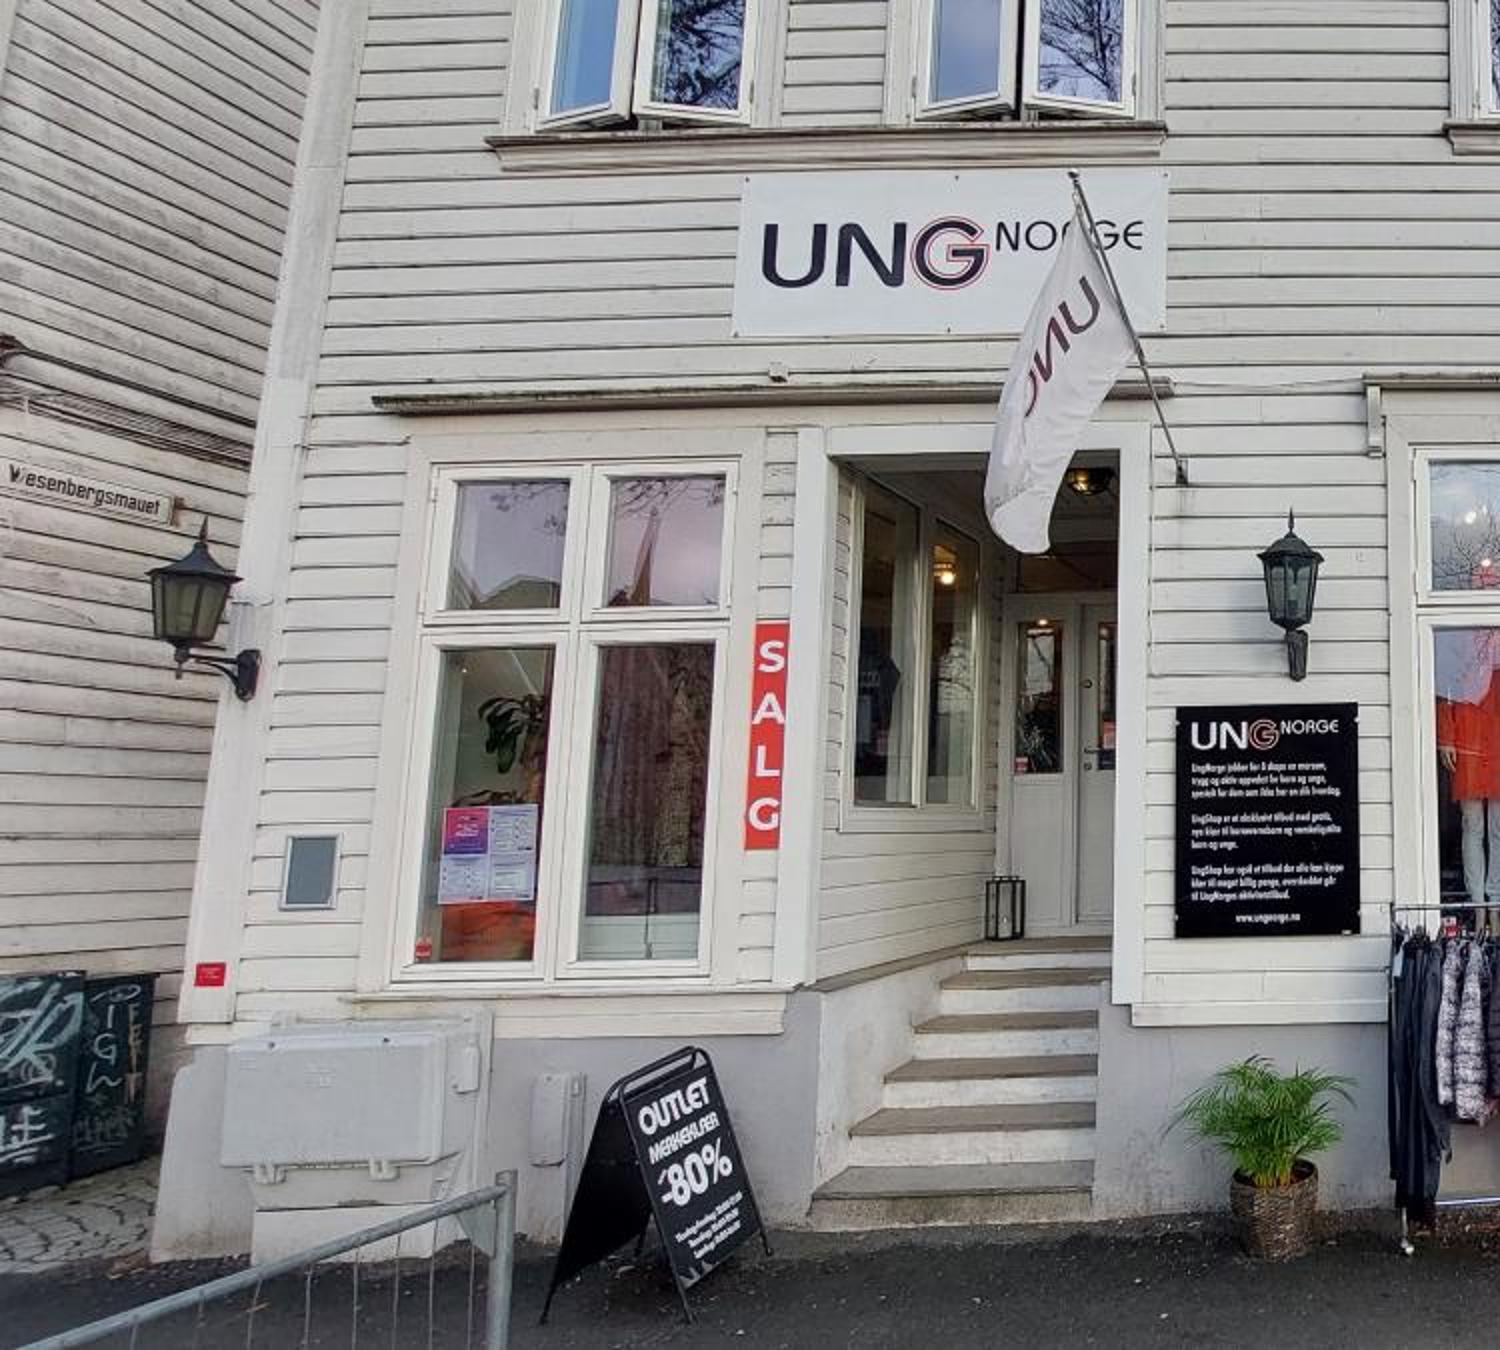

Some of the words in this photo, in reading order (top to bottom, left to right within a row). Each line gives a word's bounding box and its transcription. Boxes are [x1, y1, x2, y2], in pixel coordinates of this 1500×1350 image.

[761, 215, 991, 291] UNG
[995, 219, 1144, 252] NOGE
[748, 639, 785, 831] SALG
[1190, 718, 1280, 751] UNG
[1280, 719, 1340, 735] NORGE
[638, 1075, 710, 1136] OUTLET
